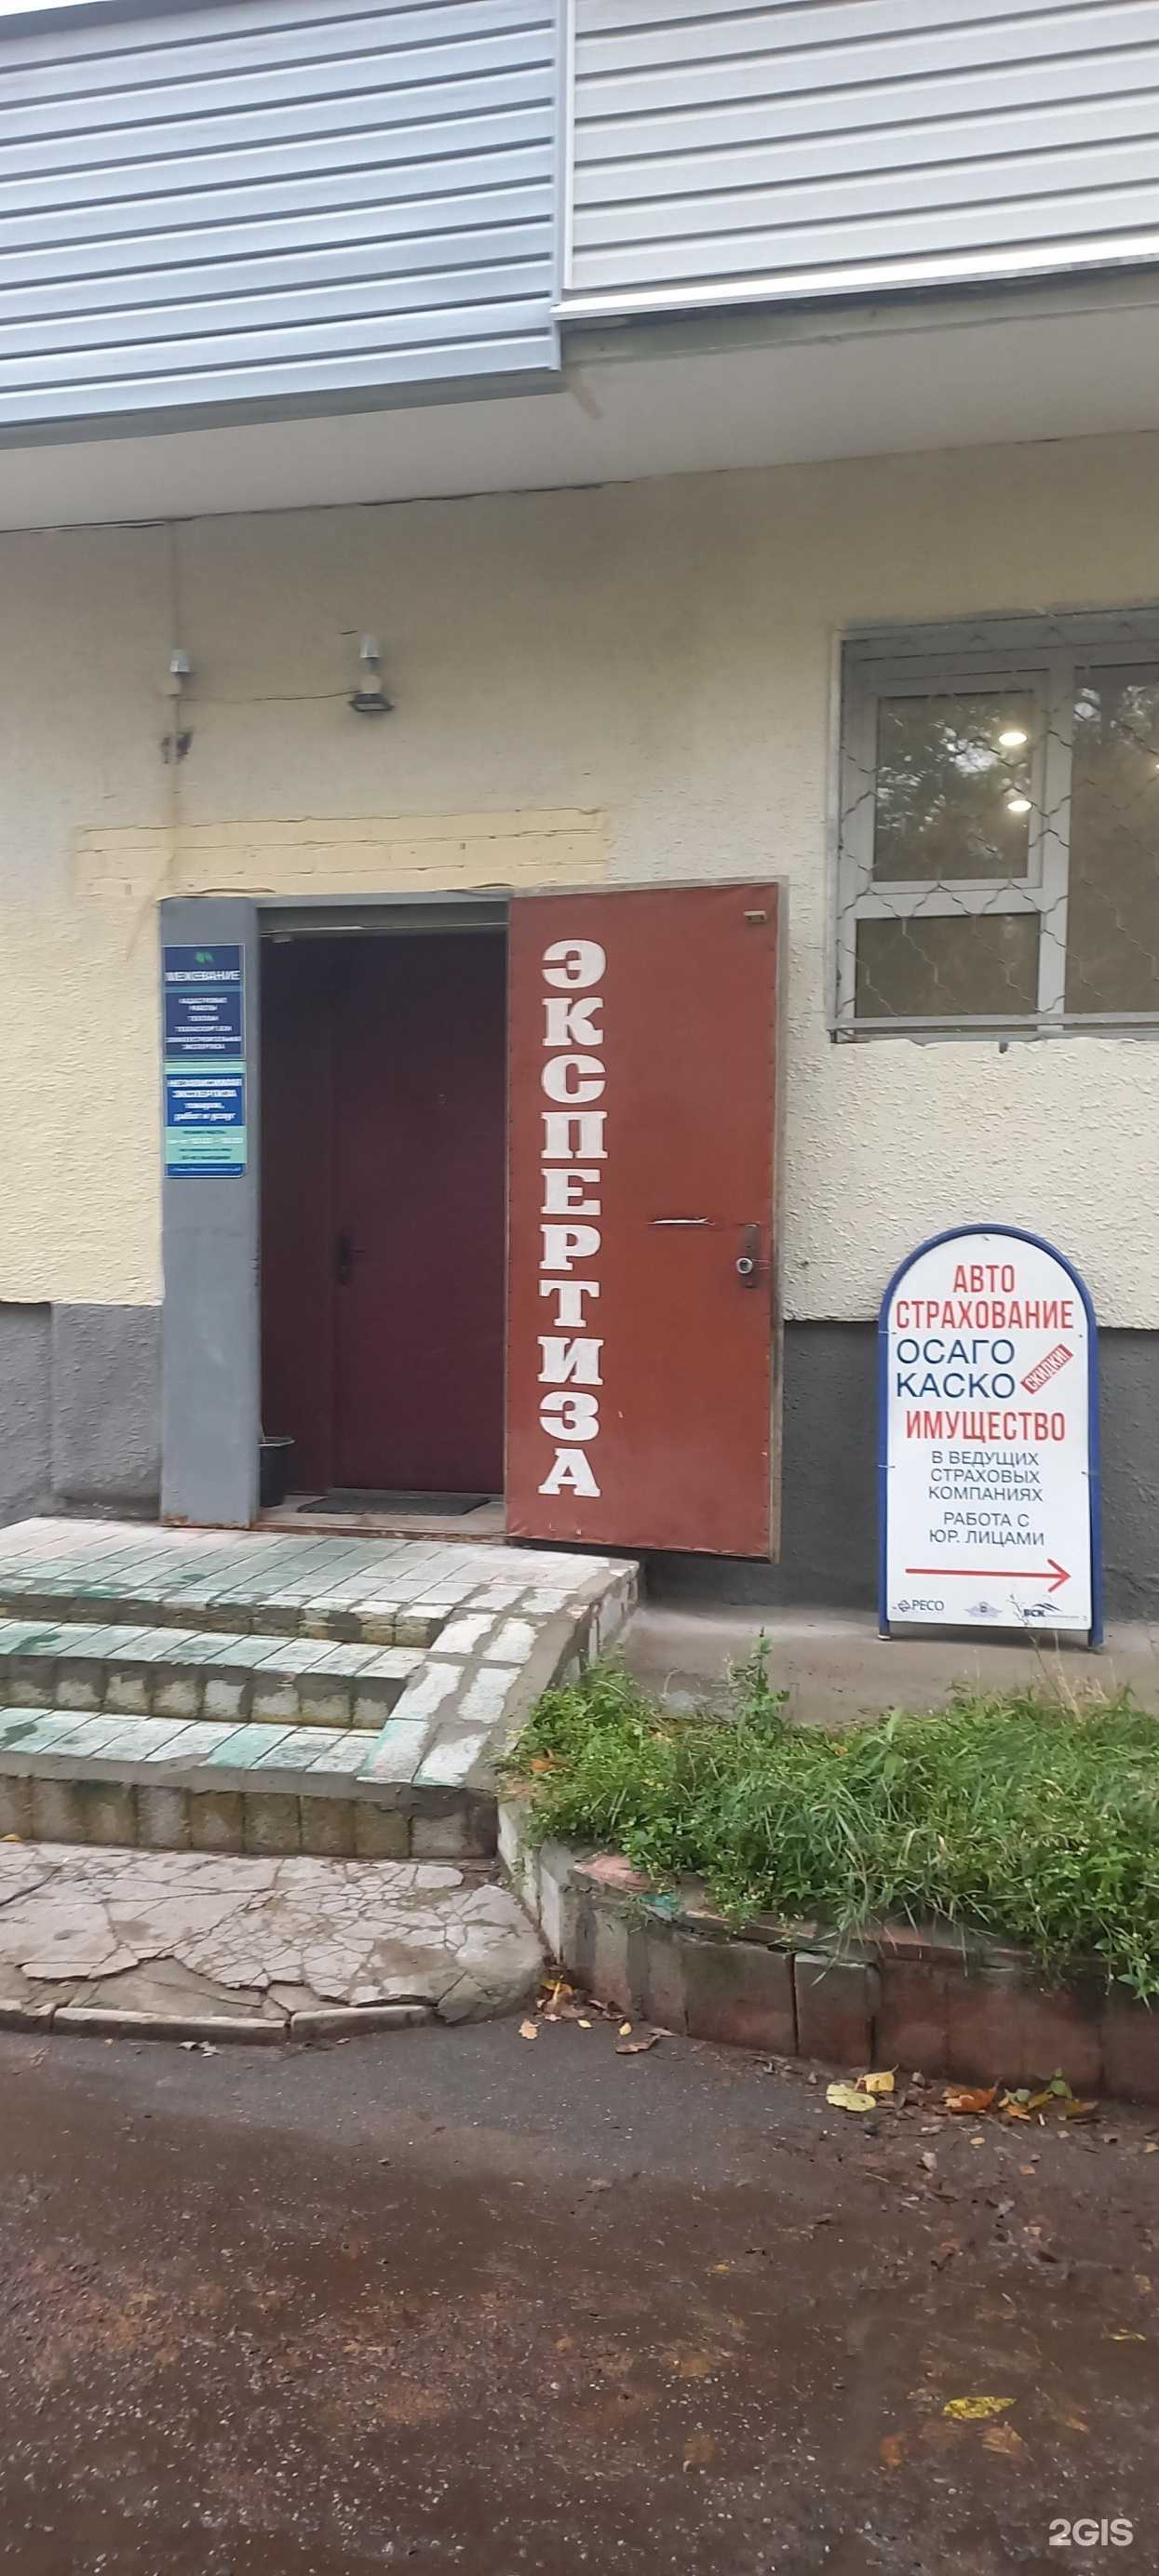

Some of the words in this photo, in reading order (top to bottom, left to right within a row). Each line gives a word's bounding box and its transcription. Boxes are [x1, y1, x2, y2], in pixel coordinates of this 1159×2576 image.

[537, 939, 608, 1496] ЭКСПЕРТИЗА
[953, 1265, 1015, 1293] АВТО
[896, 1300, 1073, 1329] СТРАХОВАНИЕ
[896, 1338, 1015, 1364] ОСАГО
[896, 1373, 1016, 1398] КАСКО
[906, 1410, 1065, 1442] ИМУЩЕСТВО
[932, 1451, 942, 1464] В
[950, 1451, 1040, 1468] ВЕДУЩИХ
[931, 1469, 1041, 1483] СТРАХОВЫХ
[929, 1486, 1043, 1502] КОМПАНИЯХ
[944, 1512, 1012, 1526] РАБОТА
[1017, 1513, 1030, 1527] С
[929, 1530, 960, 1543] ЮР.
[965, 1531, 1044, 1547] ЛИЦАМИ
[911, 1600, 945, 1612] РЕСО
